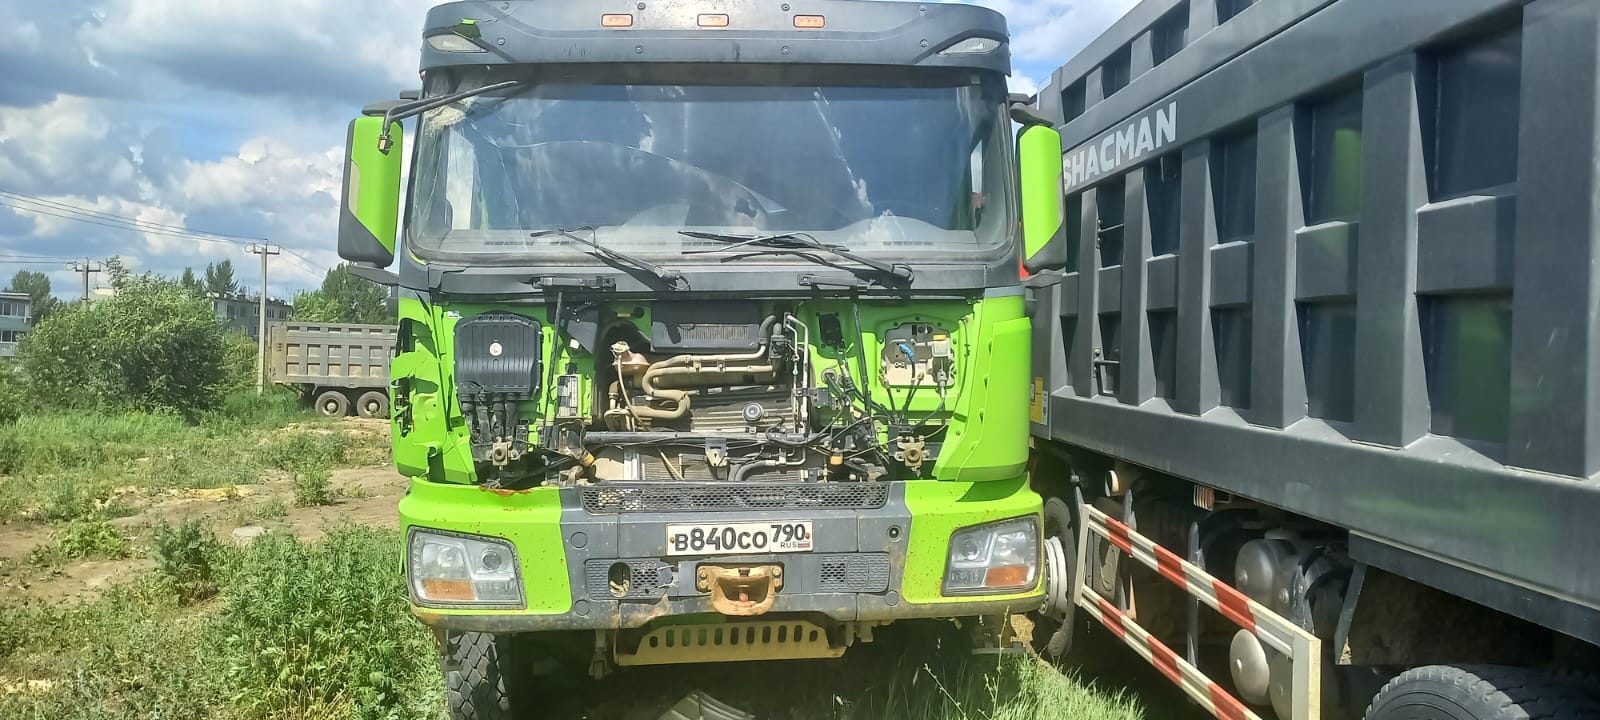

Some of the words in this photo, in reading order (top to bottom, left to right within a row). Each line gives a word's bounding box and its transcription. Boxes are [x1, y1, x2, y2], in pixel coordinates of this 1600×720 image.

[1062, 101, 1177, 191] SHACMAN
[770, 523, 806, 543] 790
[780, 541, 797, 549] RUS
